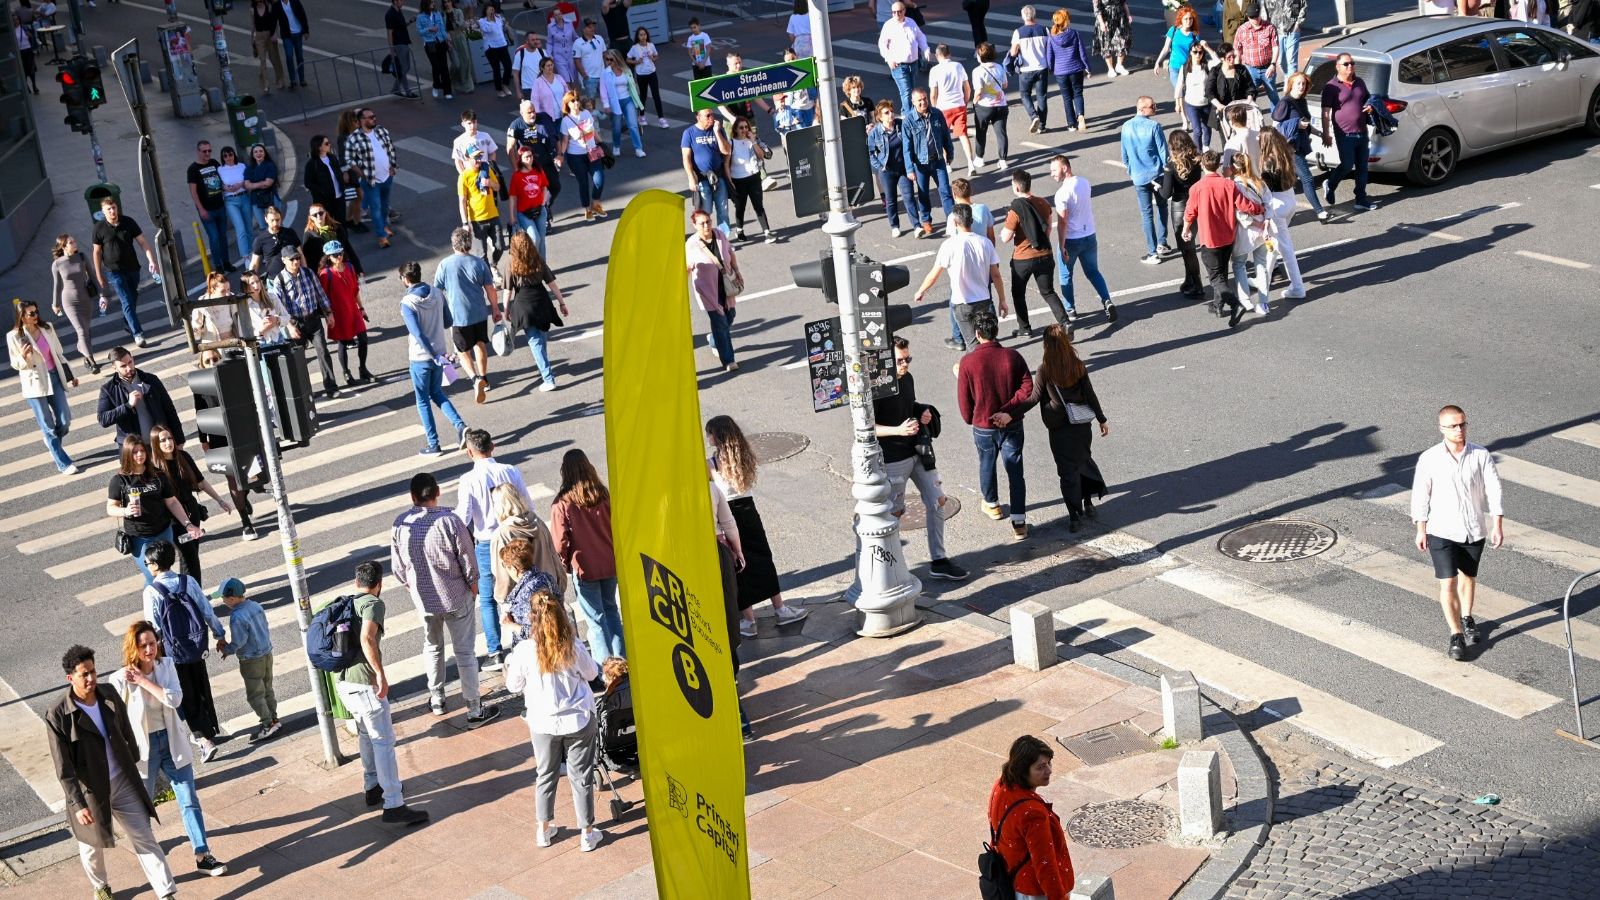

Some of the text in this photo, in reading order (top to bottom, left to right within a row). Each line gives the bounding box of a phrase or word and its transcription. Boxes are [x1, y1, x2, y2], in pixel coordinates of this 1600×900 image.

[740, 71, 767, 85] Strada
[721, 80, 788, 100] Ion Câmpineanu
